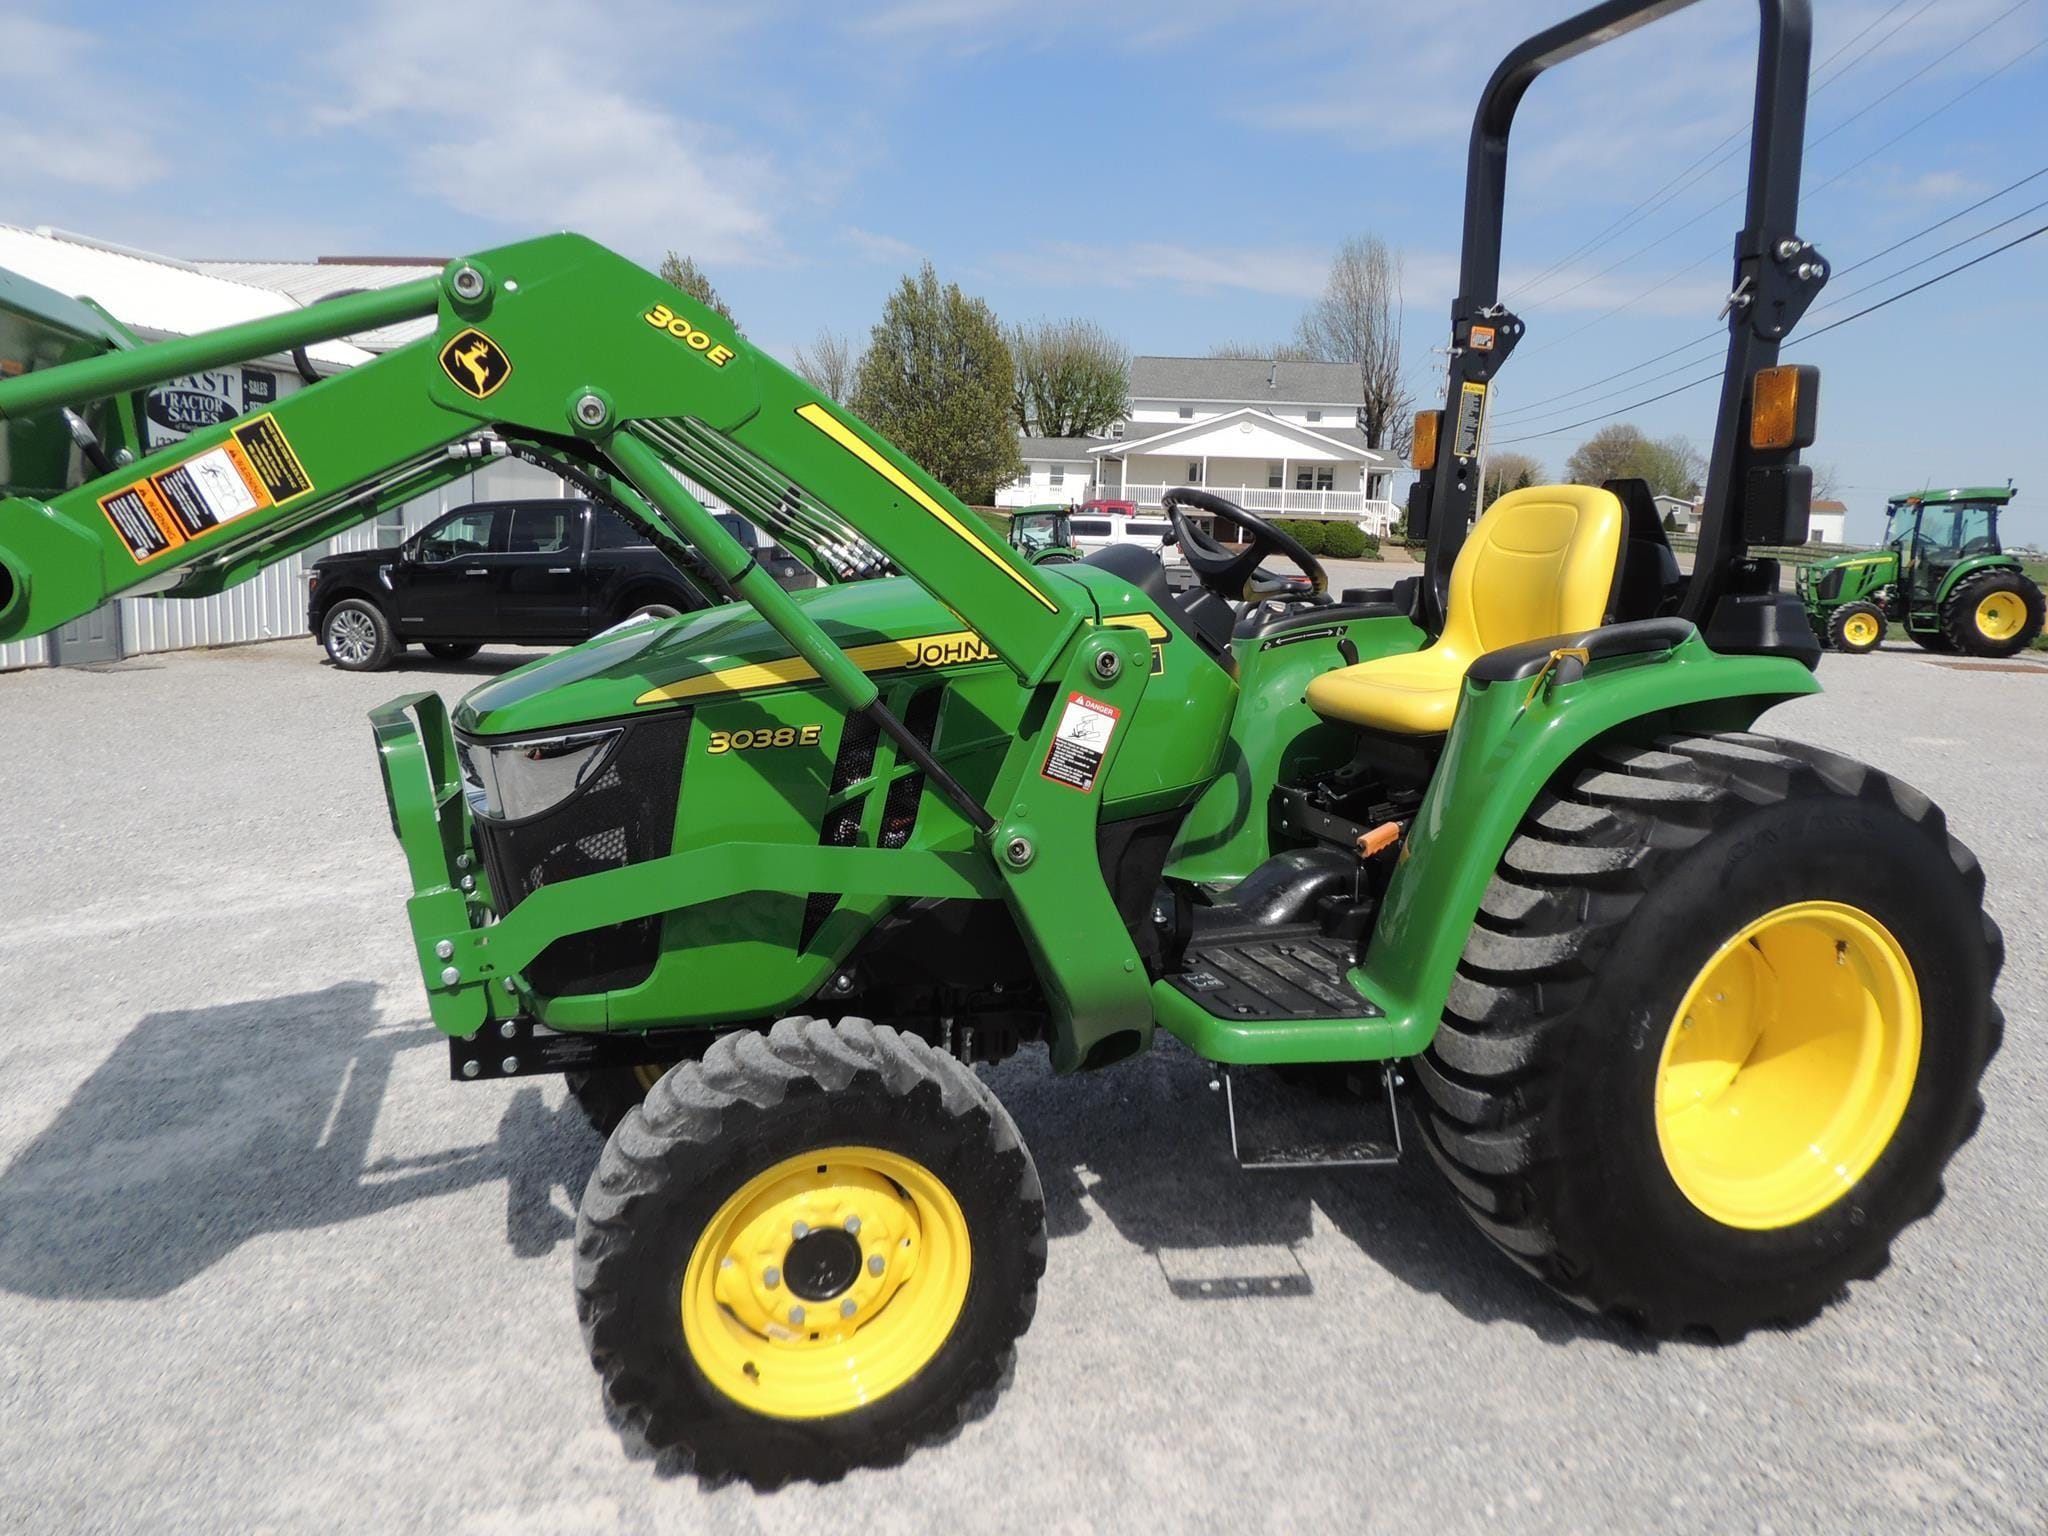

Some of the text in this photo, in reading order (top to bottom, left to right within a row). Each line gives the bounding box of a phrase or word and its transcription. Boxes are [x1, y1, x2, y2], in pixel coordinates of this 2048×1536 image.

[168, 371, 234, 398] AST
[248, 380, 268, 397] SALES
[160, 391, 224, 413] TRACTOR
[168, 407, 220, 424] SALES
[236, 458, 263, 499] WARNING
[147, 499, 175, 540] WARNING
[906, 639, 982, 667] JOHN
[1084, 699, 1114, 716] DANGER
